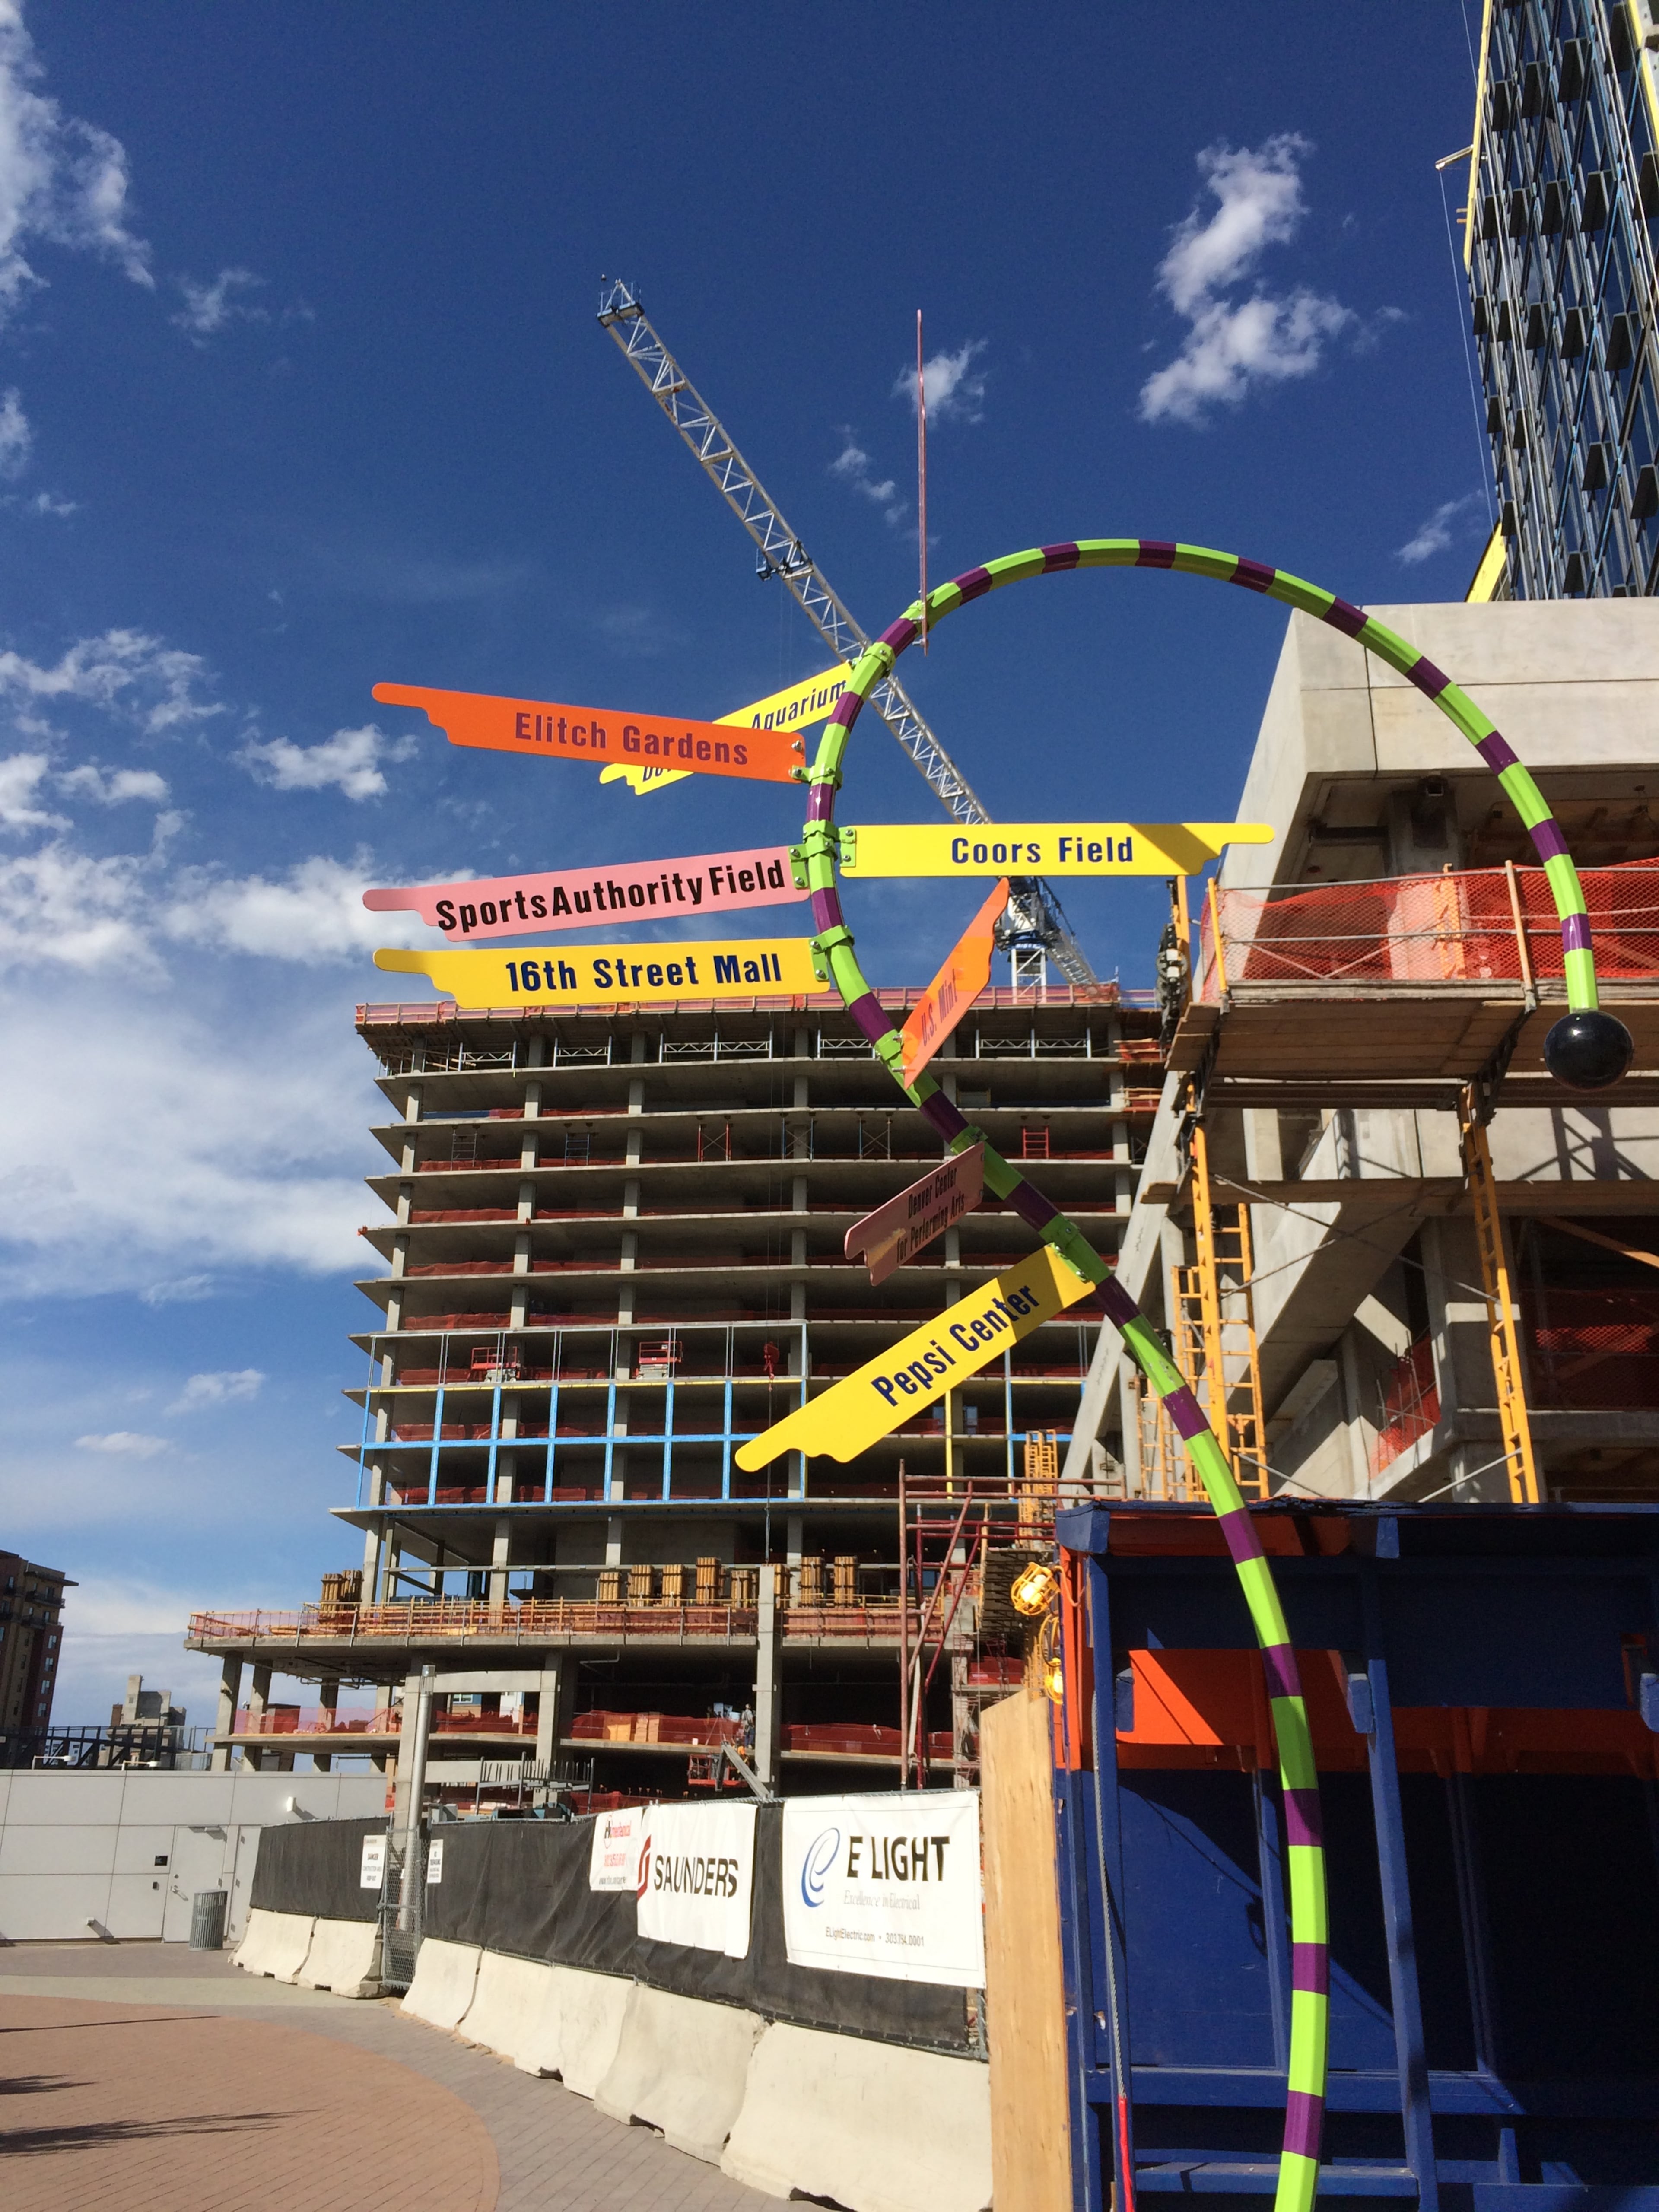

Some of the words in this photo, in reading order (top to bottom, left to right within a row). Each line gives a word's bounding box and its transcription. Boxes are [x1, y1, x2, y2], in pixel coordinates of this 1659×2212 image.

[515, 712, 606, 749] Elitch
[623, 725, 748, 765] Gardens
[952, 837, 1041, 864] Coors
[1059, 837, 1133, 862] Field
[435, 895, 547, 933] Sports
[552, 874, 703, 916] Authority
[709, 860, 785, 896] Field
[506, 961, 577, 992] 16th
[593, 956, 698, 989] Street
[713, 953, 782, 983] Mall
[921, 1002, 937, 1047] U.S.
[938, 968, 958, 1023] Mint
[909, 1185, 933, 1220] Denver
[935, 1168, 957, 1198] Center
[897, 1238, 908, 1263] for
[911, 1206, 949, 1252] Performing
[950, 1191, 965, 1220] Arts
[871, 1341, 957, 1407] Pepsi
[949, 1285, 1040, 1352] Center
[654, 1855, 738, 1898] SAUNDERS
[847, 1836, 864, 1878] E
[871, 1836, 950, 1881] LIGHT
